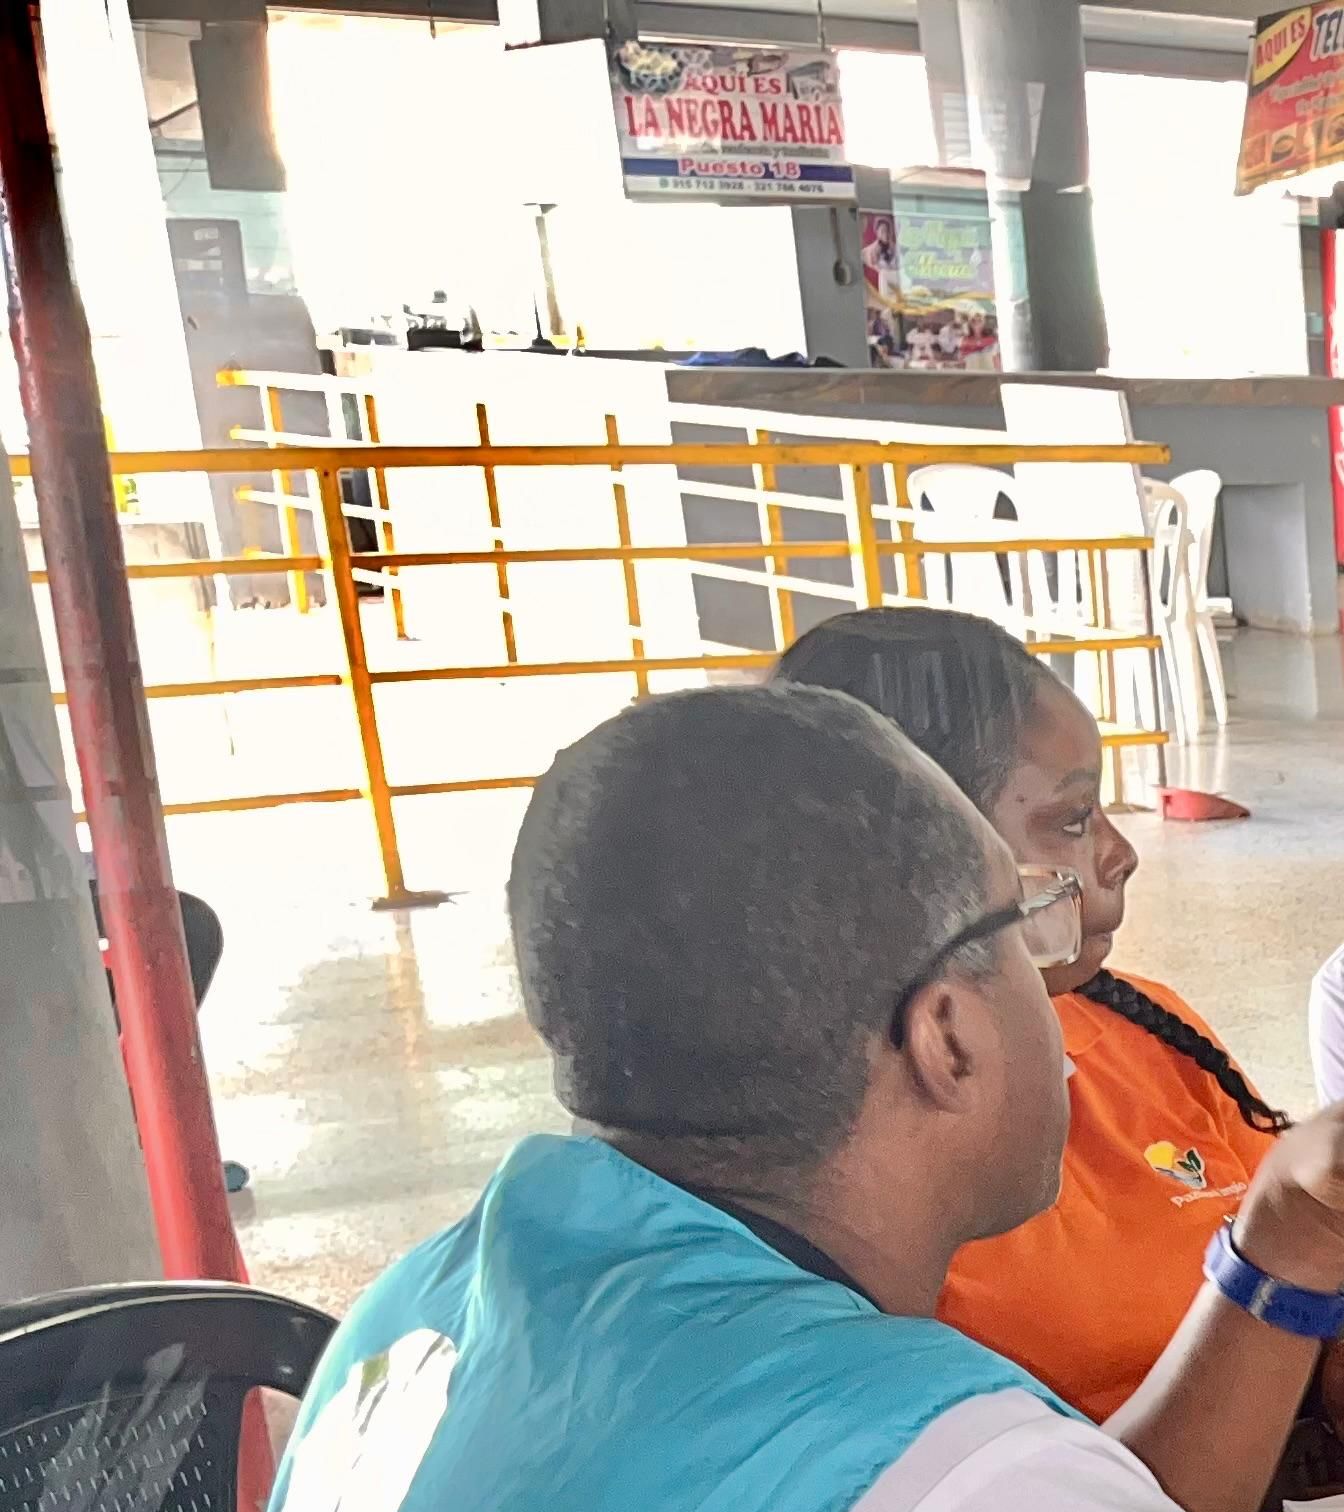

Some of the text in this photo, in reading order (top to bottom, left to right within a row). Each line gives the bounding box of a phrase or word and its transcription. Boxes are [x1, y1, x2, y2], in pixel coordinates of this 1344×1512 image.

[1291, 14, 1306, 41] ES
[753, 76, 782, 95] ES
[624, 95, 662, 138] LA
[666, 96, 757, 142] NEGRA
[680, 157, 799, 178] Puesto 18
